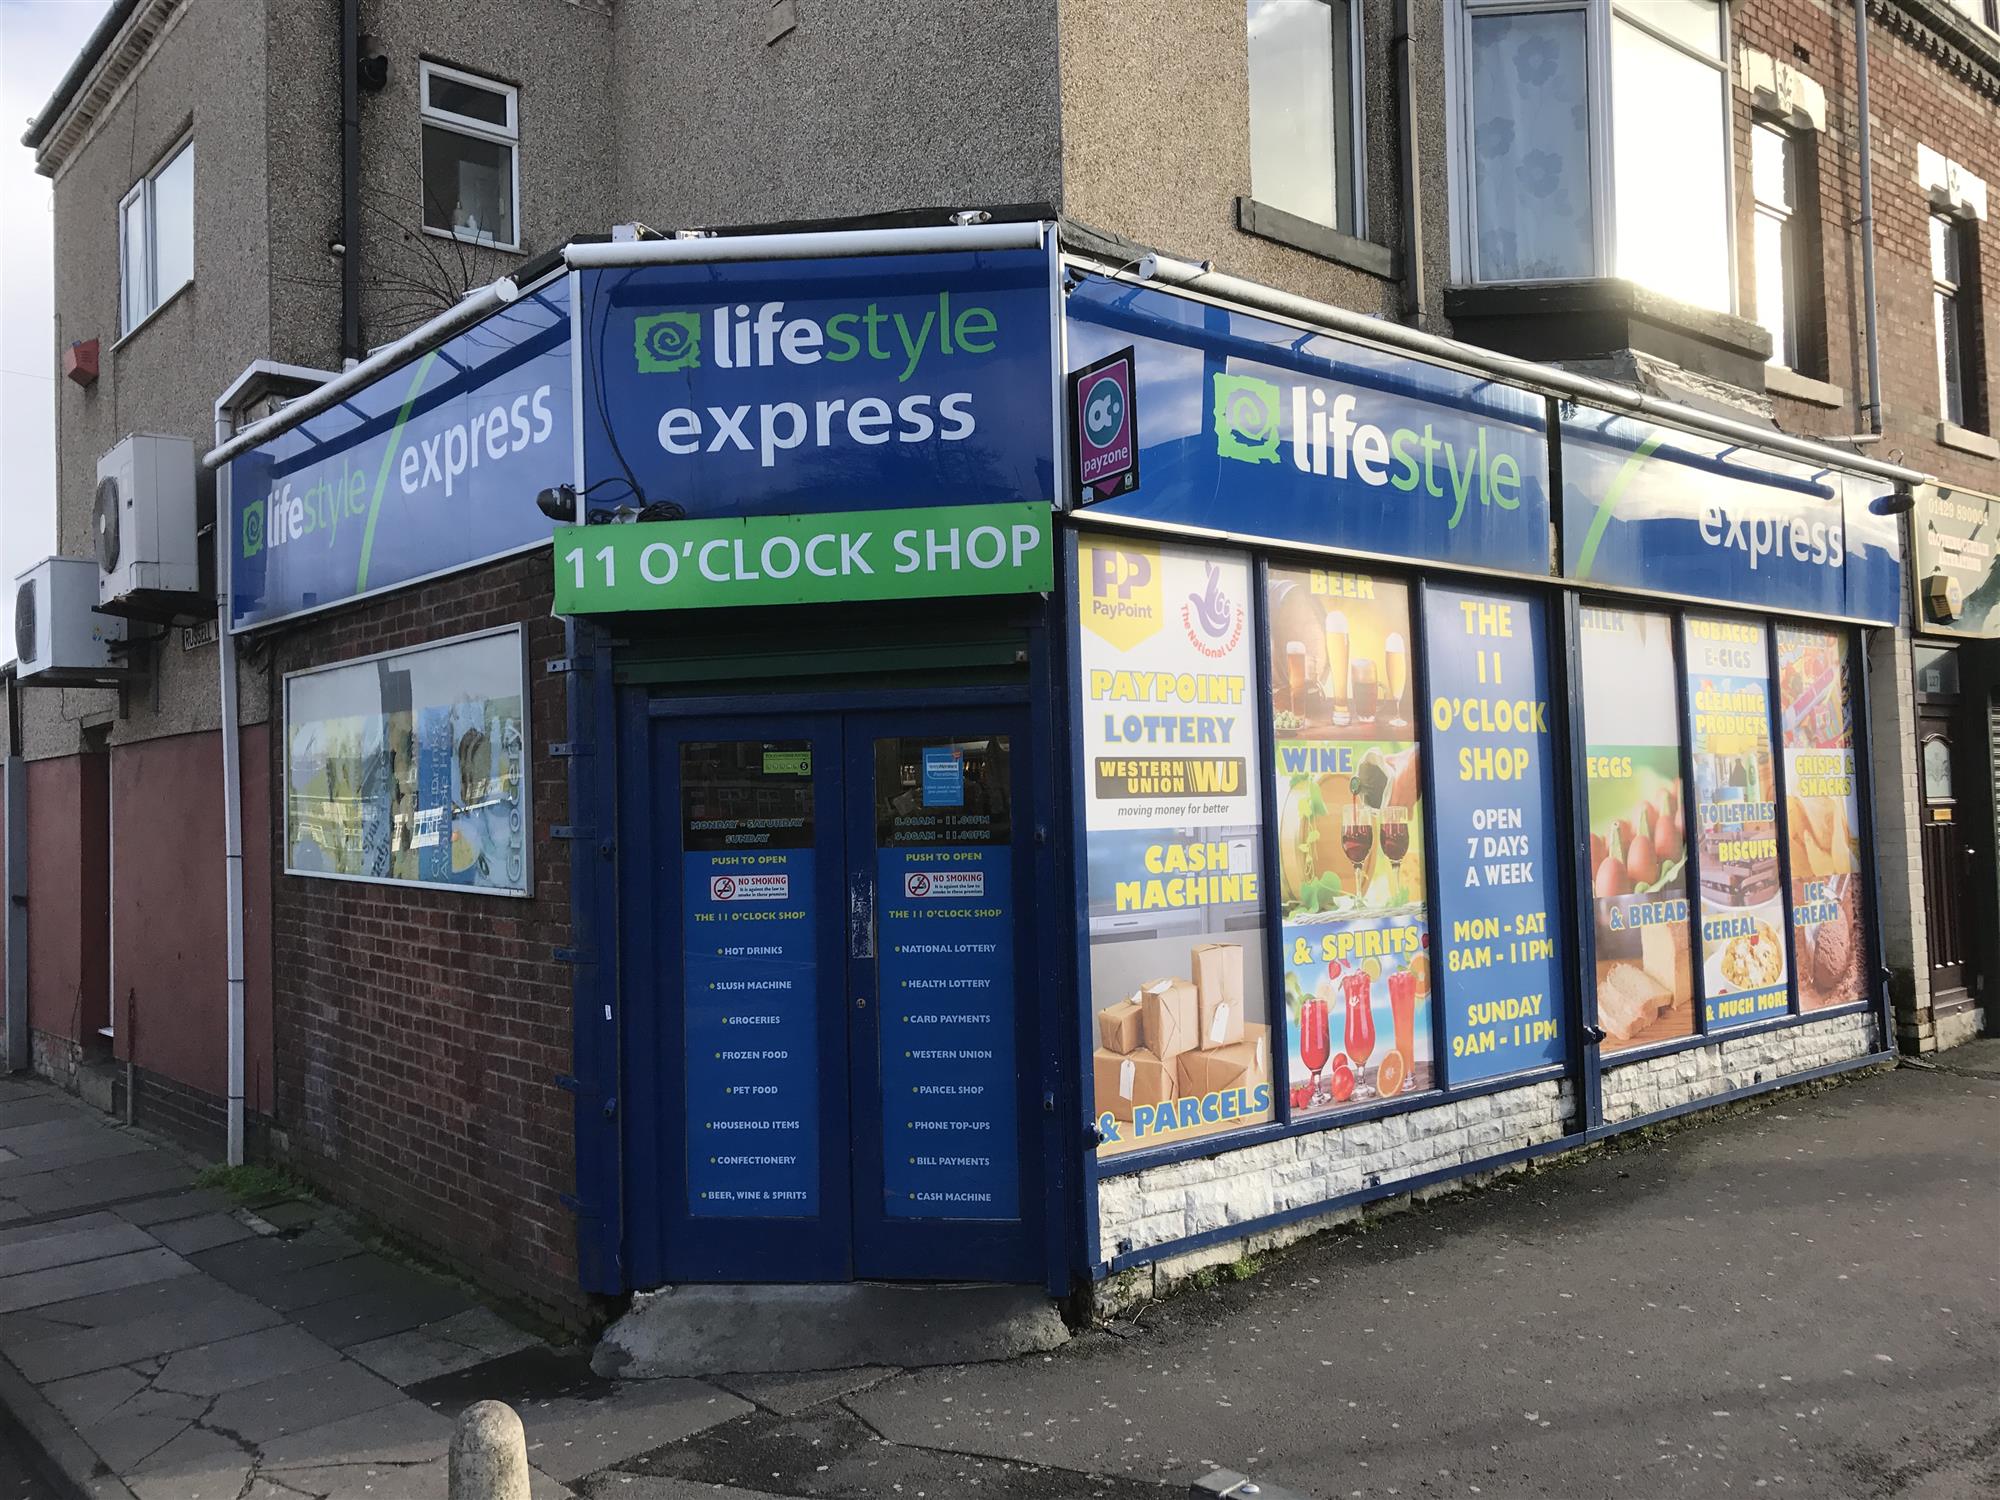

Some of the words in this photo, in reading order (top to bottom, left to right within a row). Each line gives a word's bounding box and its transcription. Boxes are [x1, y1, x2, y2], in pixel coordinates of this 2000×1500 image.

[713, 291, 998, 383] lifestyle
[400, 384, 554, 497] express
[658, 392, 976, 467] express
[1083, 447, 1128, 477] payzone
[1291, 386, 1521, 530] lifestyle
[267, 466, 366, 548] lifestyle
[1699, 505, 1845, 570] express
[564, 545, 616, 589] 11
[639, 531, 874, 585] O'CLOCK
[892, 524, 1042, 574] SHOP
[1310, 569, 1375, 600] BEER
[1093, 600, 1152, 619] PayPoint
[1459, 600, 1513, 637] THE
[1181, 604, 1191, 629] The
[1187, 629, 1226, 658] National
[1225, 608, 1244, 652] Lottery
[1690, 619, 1759, 645] TOBACCO
[1476, 650, 1502, 685] 11
[1705, 648, 1751, 669] E-CIGS
[1090, 669, 1246, 704] PAYPOINT
[1695, 690, 1766, 713] CLEANING
[1432, 697, 1548, 733] O'CLOCK
[1696, 713, 1768, 736] PRODUCTS
[1104, 714, 1235, 745] LOTTERY
[1281, 747, 1353, 773] WINE
[1459, 747, 1530, 781] SHOP
[1586, 755, 1633, 779] EGGS
[1795, 755, 1841, 776] CRISPS
[1099, 760, 1184, 778] WESTERN
[1193, 760, 1240, 793] WU
[1127, 777, 1185, 794] UNION
[1800, 776, 1851, 797] SNACKS
[504, 718, 523, 883] Grocery
[1118, 805, 1153, 818] moving
[1155, 804, 1186, 817] money
[1188, 803, 1201, 814] for
[1203, 803, 1229, 814] better
[691, 820, 738, 830] MONDAY
[746, 818, 804, 829] SATURDAY
[1472, 808, 1522, 830] OPEN
[1700, 801, 1776, 824] TOILETRIES
[725, 833, 770, 844] SUNDAY
[1467, 838, 1478, 859] 7
[1483, 835, 1529, 858] DAYS
[712, 856, 739, 865] PUSH
[741, 856, 755, 864] TO
[759, 855, 787, 864] OPEN
[906, 853, 933, 862] PUSH
[935, 853, 950, 861] TO
[953, 852, 982, 861] OPEN
[1144, 842, 1229, 874] CASH
[1719, 839, 1778, 862] BISCUITS
[751, 877, 786, 885] SMOKING
[946, 874, 982, 882] SMOKING
[1464, 866, 1480, 887] A
[1483, 862, 1534, 886] WEEK
[1115, 873, 1258, 912] MACHINE
[1803, 881, 1824, 903] ICE
[695, 913, 714, 921] THE
[718, 913, 728, 921] 11
[731, 912, 776, 921] O'CLOCK
[779, 911, 806, 920] SHOP
[889, 910, 909, 919] THE
[912, 910, 923, 918] 11
[926, 909, 972, 918] O'CLOCK
[974, 909, 1002, 918] SHOP
[1610, 907, 1625, 931] &
[1629, 898, 1690, 927] BREAD
[1793, 903, 1838, 927] CREAM
[1453, 917, 1499, 943] MON
[1504, 924, 1512, 933] -
[1515, 911, 1547, 936] SAT
[1702, 917, 1758, 942] CEREAL
[724, 947, 744, 955] HOT
[746, 946, 783, 955] DRINKS
[901, 945, 953, 953] NATIONAL
[954, 944, 996, 952] LOTTERY
[1293, 937, 1314, 966] &
[1321, 925, 1420, 962] SPIRITS
[1448, 946, 1491, 972] 8AM
[1496, 953, 1504, 961] -
[1510, 938, 1554, 964] 11PM
[716, 981, 745, 990] SLUSH
[747, 980, 792, 989] MACHINE
[908, 980, 946, 988] HEALTH
[948, 979, 991, 988] LOTTERY
[1468, 994, 1543, 1026] SUNDAY
[1705, 1006, 1715, 1021] &
[1718, 998, 1755, 1019] MUCH
[1758, 990, 1788, 1010] MORE
[729, 1016, 780, 1025] GROCERIES
[910, 1015, 938, 1023] CARD
[940, 1015, 991, 1023] PAYMENTS
[1452, 1030, 1495, 1057] 9AM
[1500, 1036, 1508, 1044] -
[1514, 1019, 1557, 1047] 11PM
[722, 1051, 760, 1060] FROZEN
[762, 1050, 788, 1059] FOOD
[912, 1050, 957, 1059] WESTERN
[959, 1050, 992, 1059] UNION
[733, 1086, 750, 1094] PET
[752, 1086, 778, 1094] FOOD
[920, 1086, 957, 1094] PARCEL
[958, 1086, 984, 1094] SHOP
[713, 1121, 770, 1129] HOUSEHOLD
[772, 1121, 800, 1129] ITEMS
[914, 1121, 949, 1130] PHONE
[950, 1121, 990, 1130] TOP-UPS
[1099, 1112, 1122, 1144] &
[1133, 1084, 1270, 1137] PARCELS
[717, 1156, 797, 1165] CONFECTIONERY
[917, 1157, 937, 1165] BILL
[939, 1157, 990, 1166] PAYMENTS
[708, 1191, 735, 1200] BEER,
[736, 1191, 761, 1199] WINE
[763, 1191, 770, 1199] &
[772, 1191, 807, 1200] SPIRITS
[917, 1192, 943, 1201] CASH
[945, 1192, 991, 1202] MACHINE
